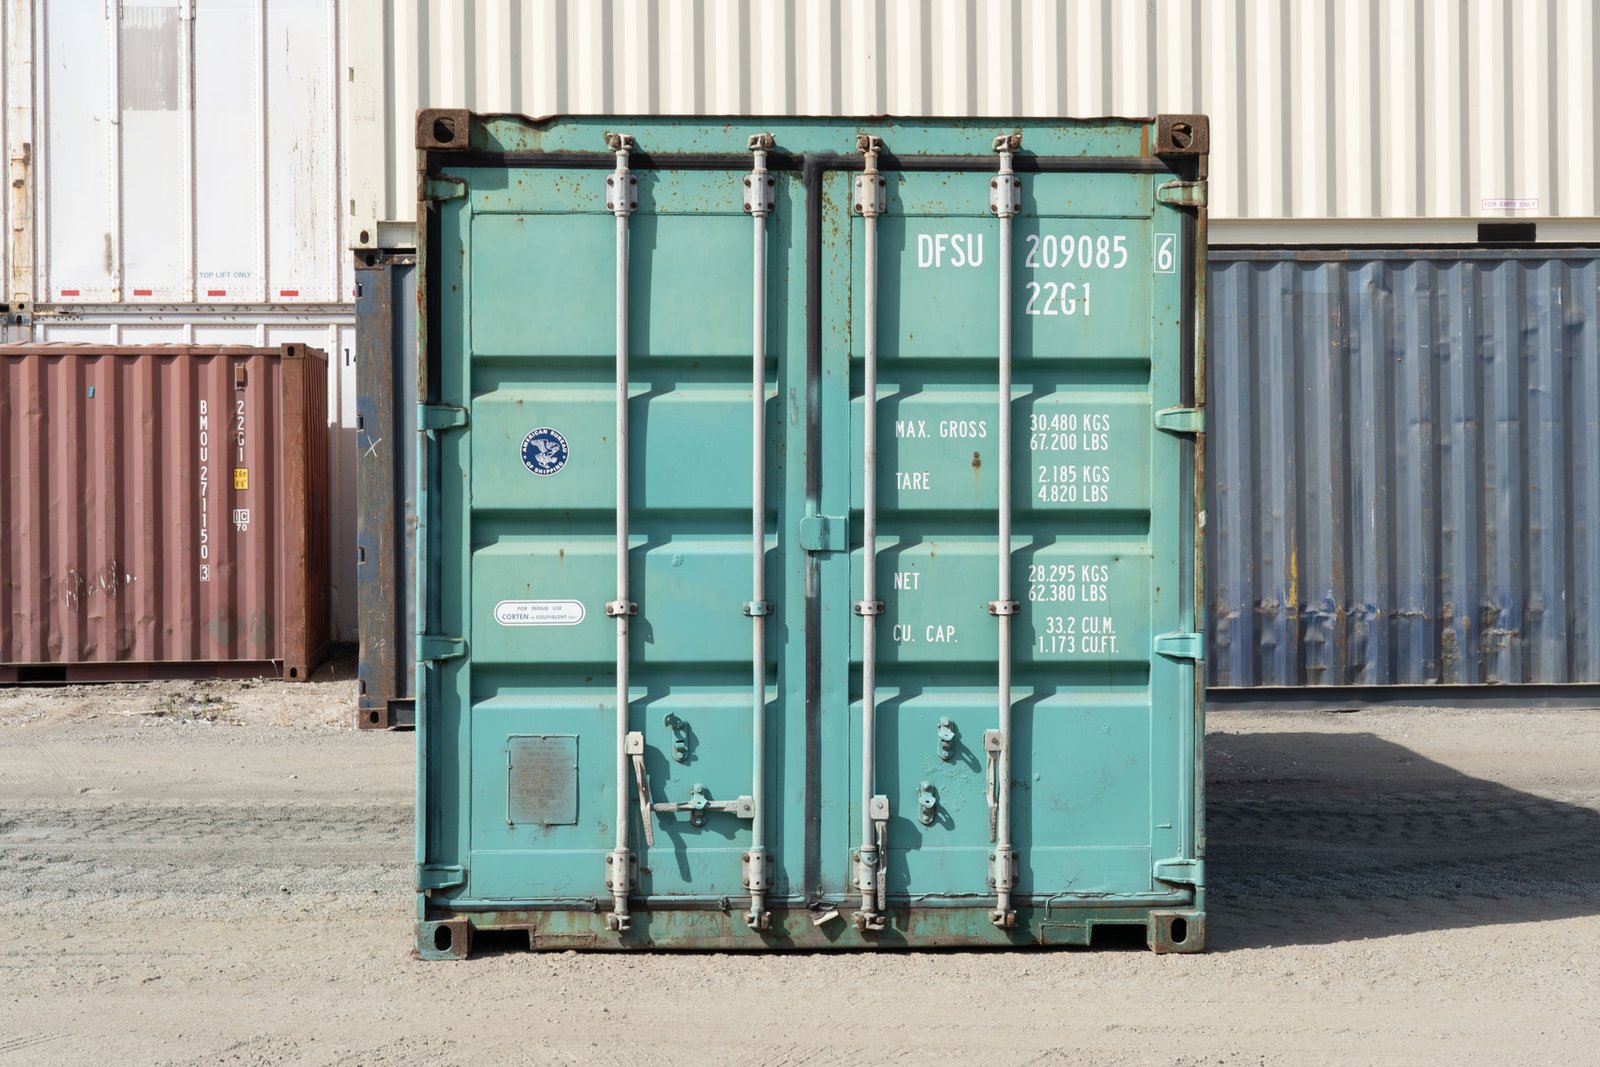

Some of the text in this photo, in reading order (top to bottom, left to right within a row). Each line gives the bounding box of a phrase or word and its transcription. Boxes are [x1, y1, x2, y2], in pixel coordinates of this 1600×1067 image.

[917, 233, 1173, 270] DFSU 209085 6
[1025, 281, 1091, 316] 22G1
[237, 400, 245, 462] 22G1
[895, 420, 987, 438] MAX. GROSS
[1083, 414, 1110, 431] KGS
[522, 429, 567, 453] AMERICAN BUREAU
[1083, 433, 1109, 451] LBS
[526, 461, 564, 475] OF SHIPPING
[1083, 465, 1110, 483] KGS
[200, 399, 208, 580] BMOU 271150 3
[895, 472, 931, 490] TARE
[1083, 485, 1109, 502] LBS
[236, 524, 248, 532] 70
[894, 572, 920, 590] NET
[1081, 564, 1109, 582] KGS
[1081, 584, 1107, 602] LBS
[893, 624, 959, 643] CU. CAP.
[1046, 616, 1116, 634] 33.2 CU.M.
